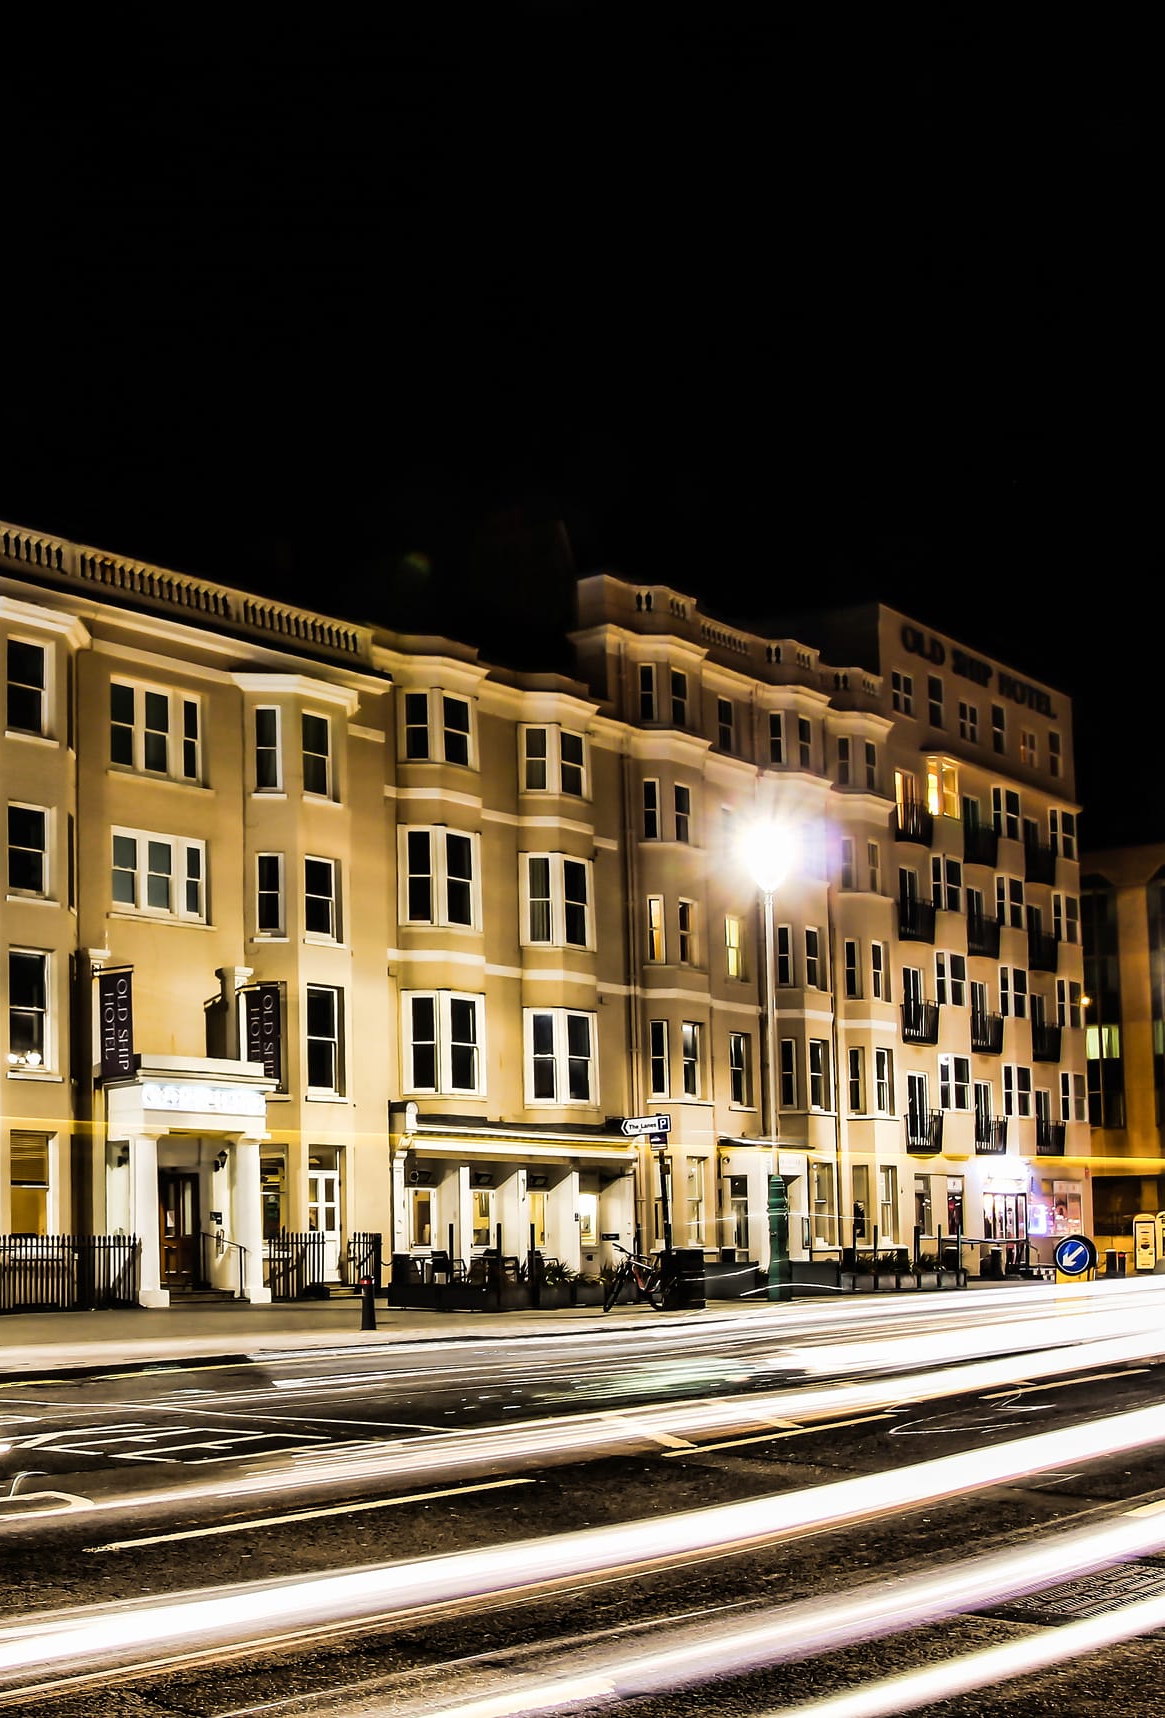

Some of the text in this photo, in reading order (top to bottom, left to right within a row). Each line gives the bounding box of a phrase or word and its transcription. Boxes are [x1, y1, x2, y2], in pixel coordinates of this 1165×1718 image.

[900, 624, 946, 667] OLD
[103, 992, 116, 1060] HOTEL
[117, 978, 130, 1070] OLD SHIP
[250, 1007, 261, 1062] HOTE
[263, 994, 274, 1035] OLD
